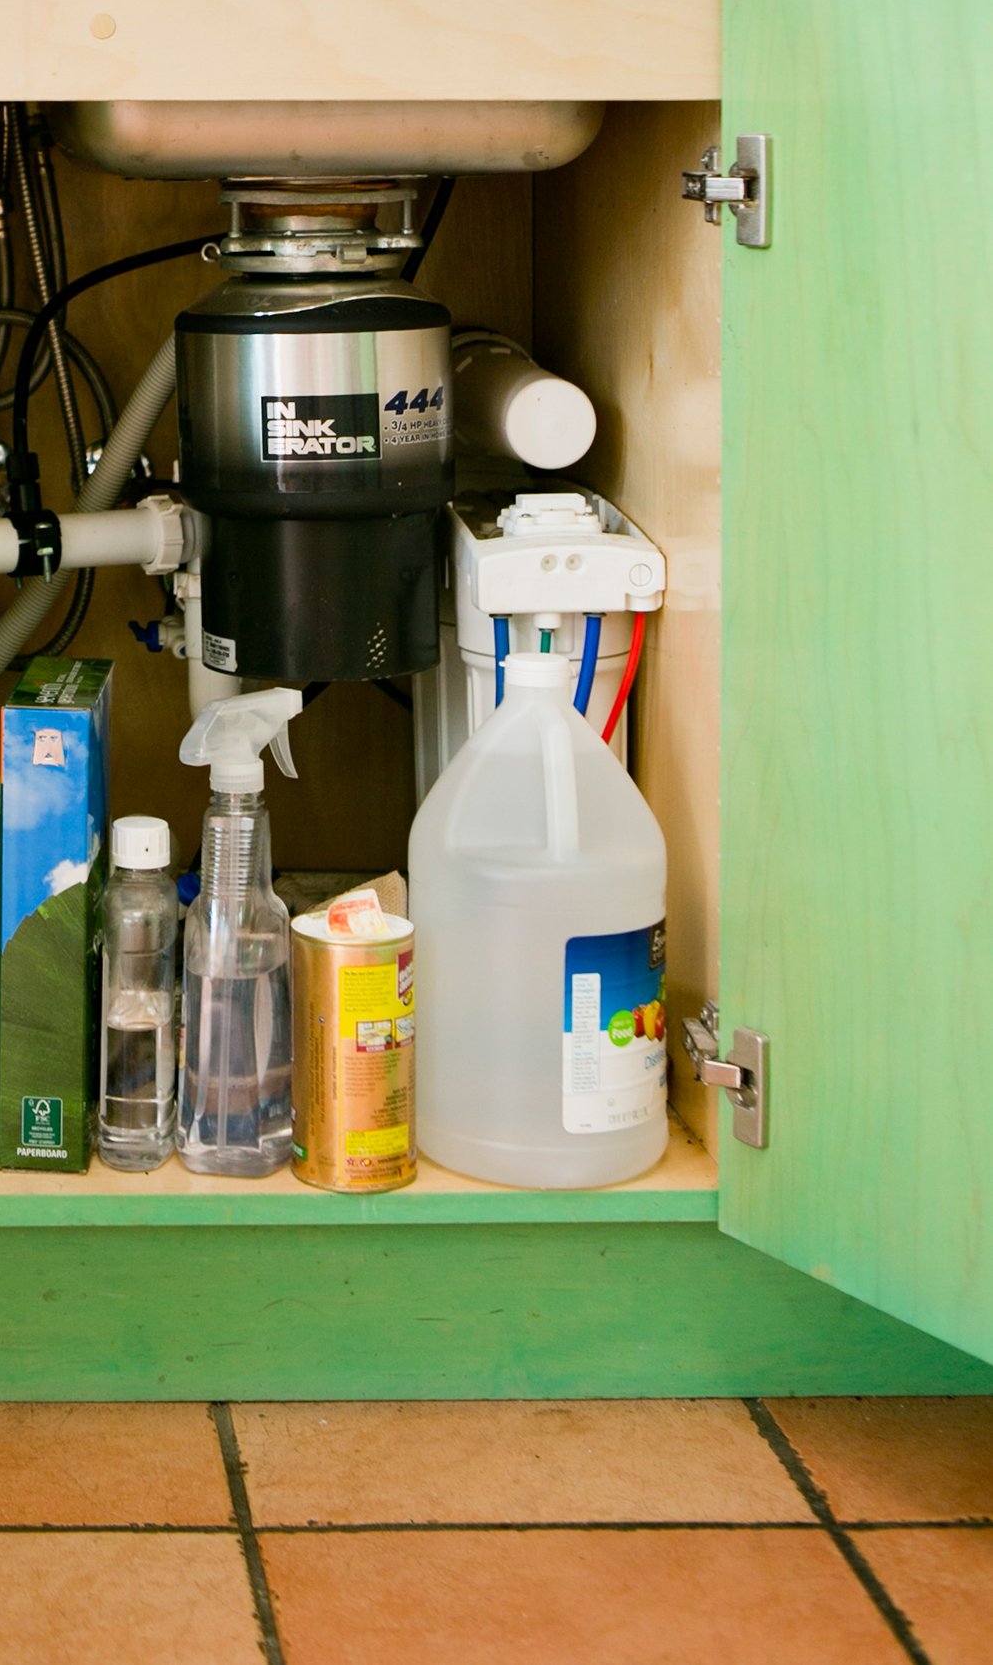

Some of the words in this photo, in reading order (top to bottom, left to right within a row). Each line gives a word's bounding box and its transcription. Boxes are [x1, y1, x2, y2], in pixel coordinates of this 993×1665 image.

[384, 386, 444, 415] 444
[266, 401, 296, 420] IN
[267, 419, 337, 437] SINK
[391, 420, 408, 432] 3/4
[410, 420, 422, 430] HP
[267, 436, 376, 455] ERATOR
[16, 1147, 68, 1159] PAPERBOARD
